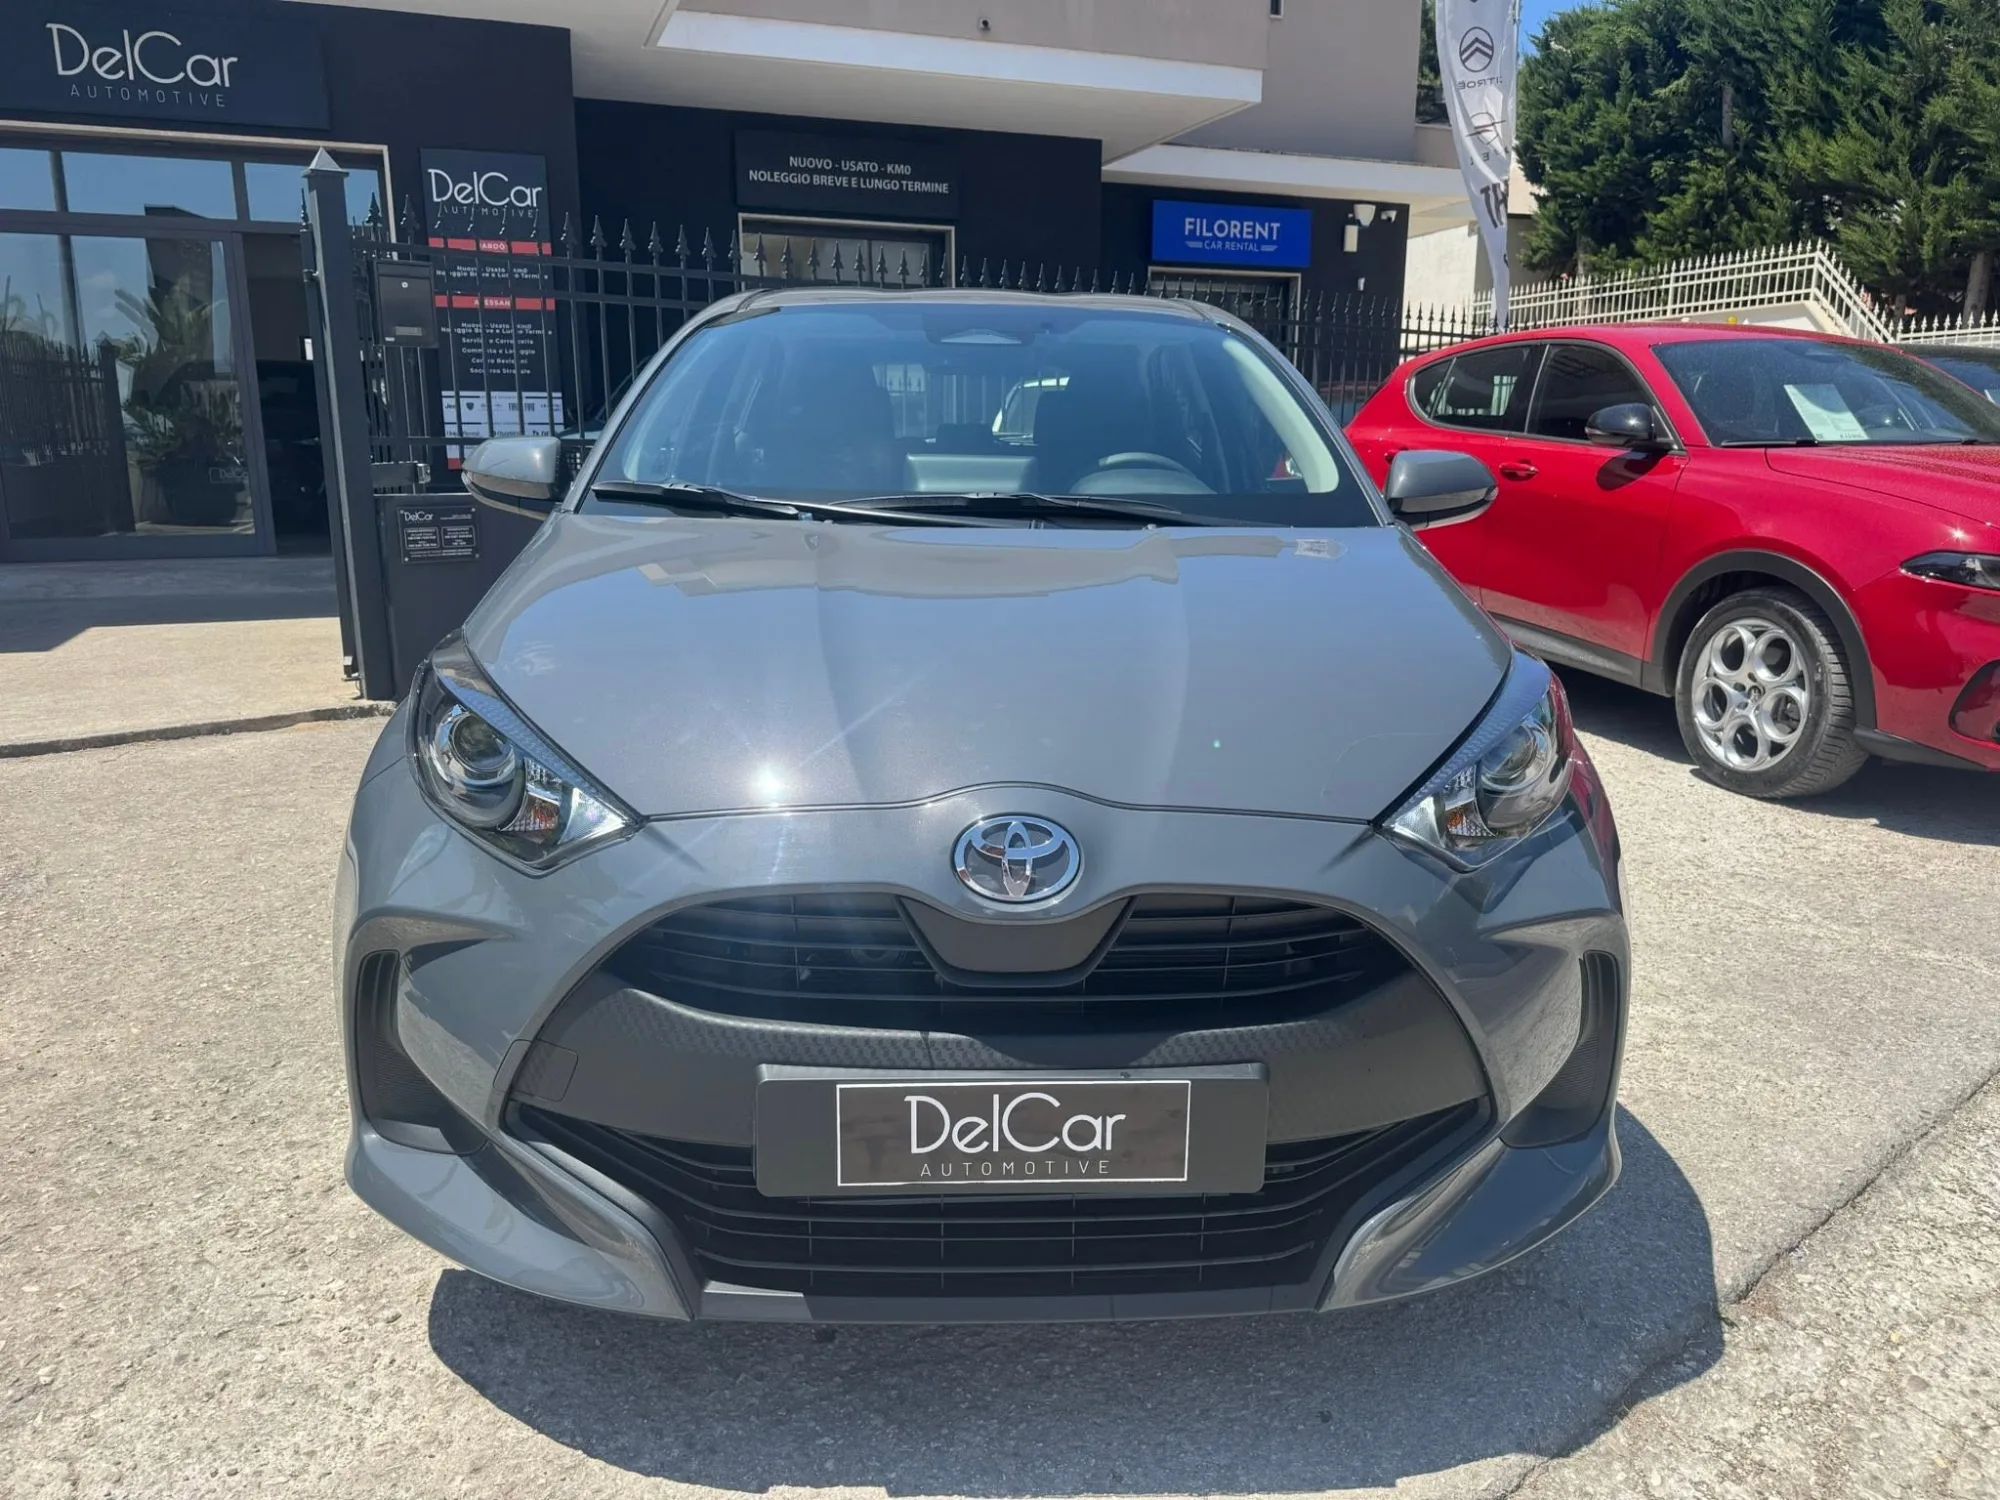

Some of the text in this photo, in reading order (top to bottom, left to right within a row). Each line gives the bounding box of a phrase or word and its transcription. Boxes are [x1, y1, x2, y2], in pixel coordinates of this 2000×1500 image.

[45, 23, 238, 87] DelCar
[70, 83, 226, 108] AUTOMOTIVE
[789, 156, 833, 170] NUOVO
[841, 160, 879, 173] USATO
[427, 168, 543, 208] DelCar
[749, 170, 950, 194] NOLEGGIO BREVE E LUNGO TERMINE
[1185, 217, 1280, 240] FILORENT
[1204, 240, 1259, 252] CAR RENTAL
[404, 511, 434, 522] DelCar
[904, 1091, 1127, 1155] DelCar
[920, 1159, 1111, 1178] AUTOMOTIVE
